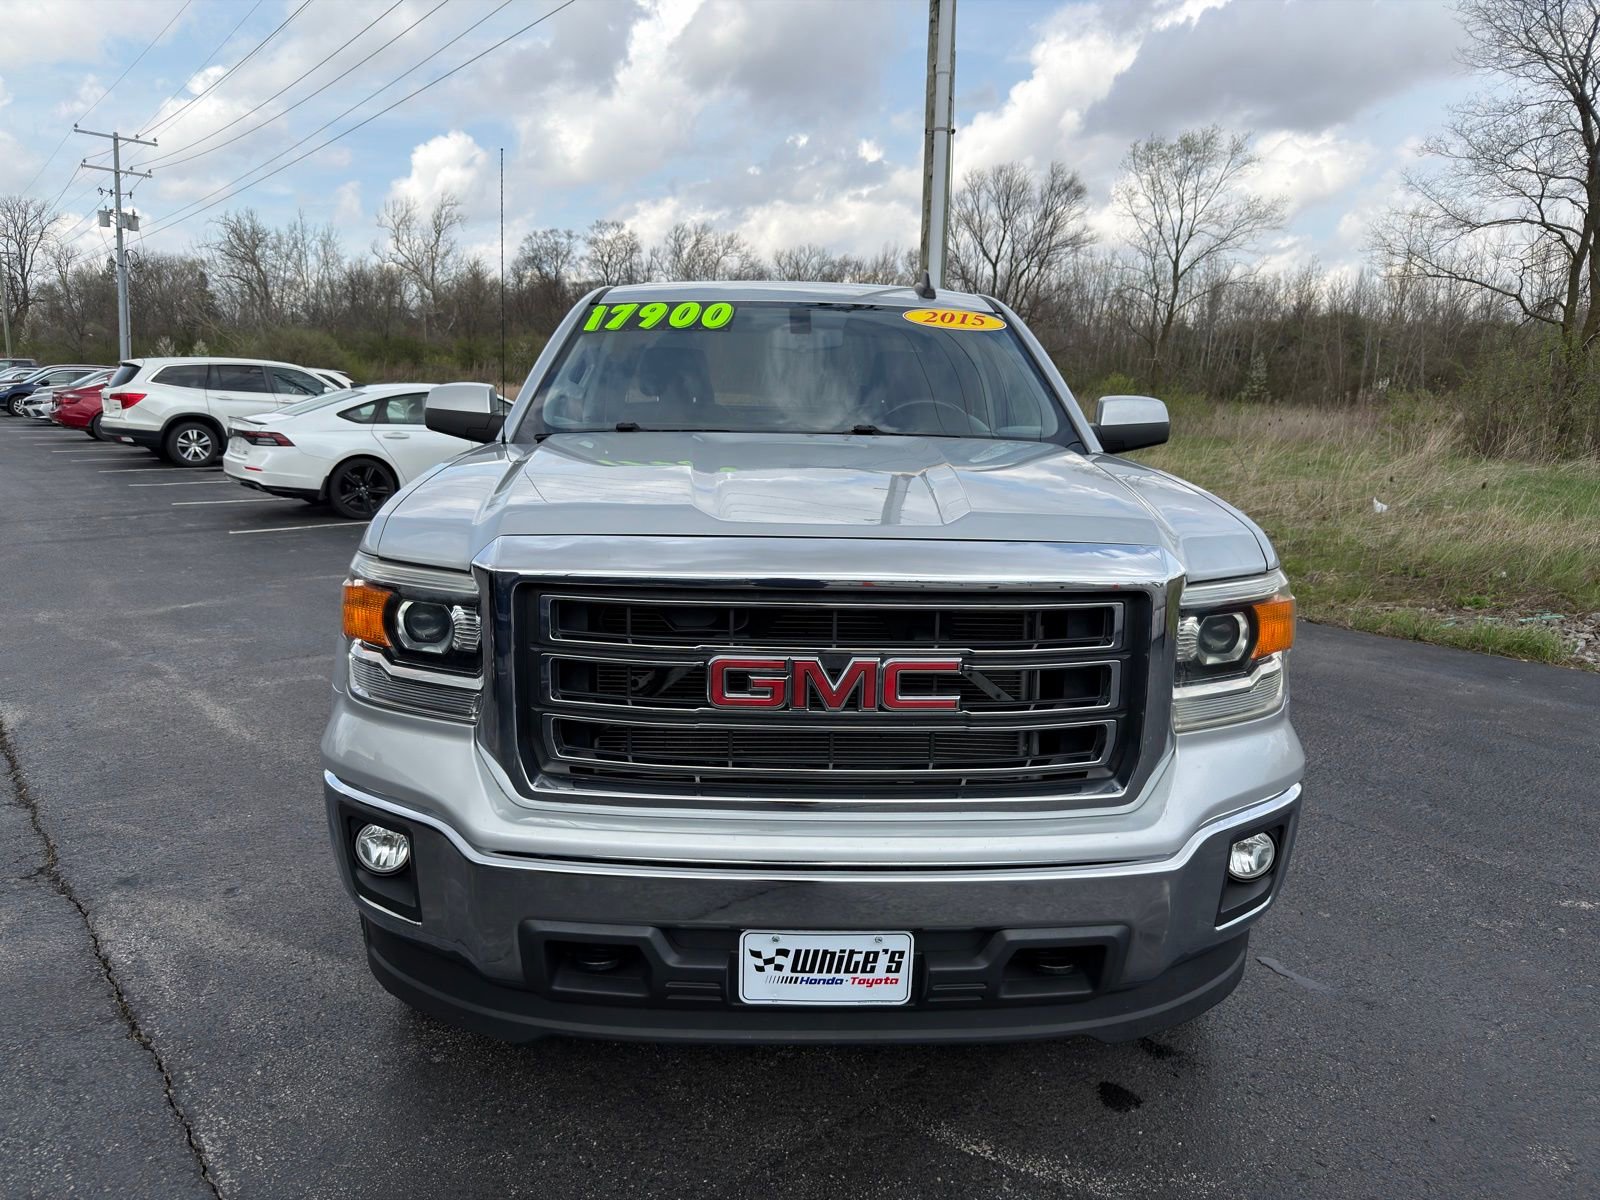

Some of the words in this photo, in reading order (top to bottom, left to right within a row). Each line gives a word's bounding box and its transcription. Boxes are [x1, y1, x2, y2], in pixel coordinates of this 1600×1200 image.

[583, 302, 735, 332] 17900
[923, 311, 986, 326] 2015
[707, 655, 962, 712] GMC
[790, 948, 906, 974] White's
[799, 976, 844, 985] Honda
[850, 976, 899, 988] Toyota
